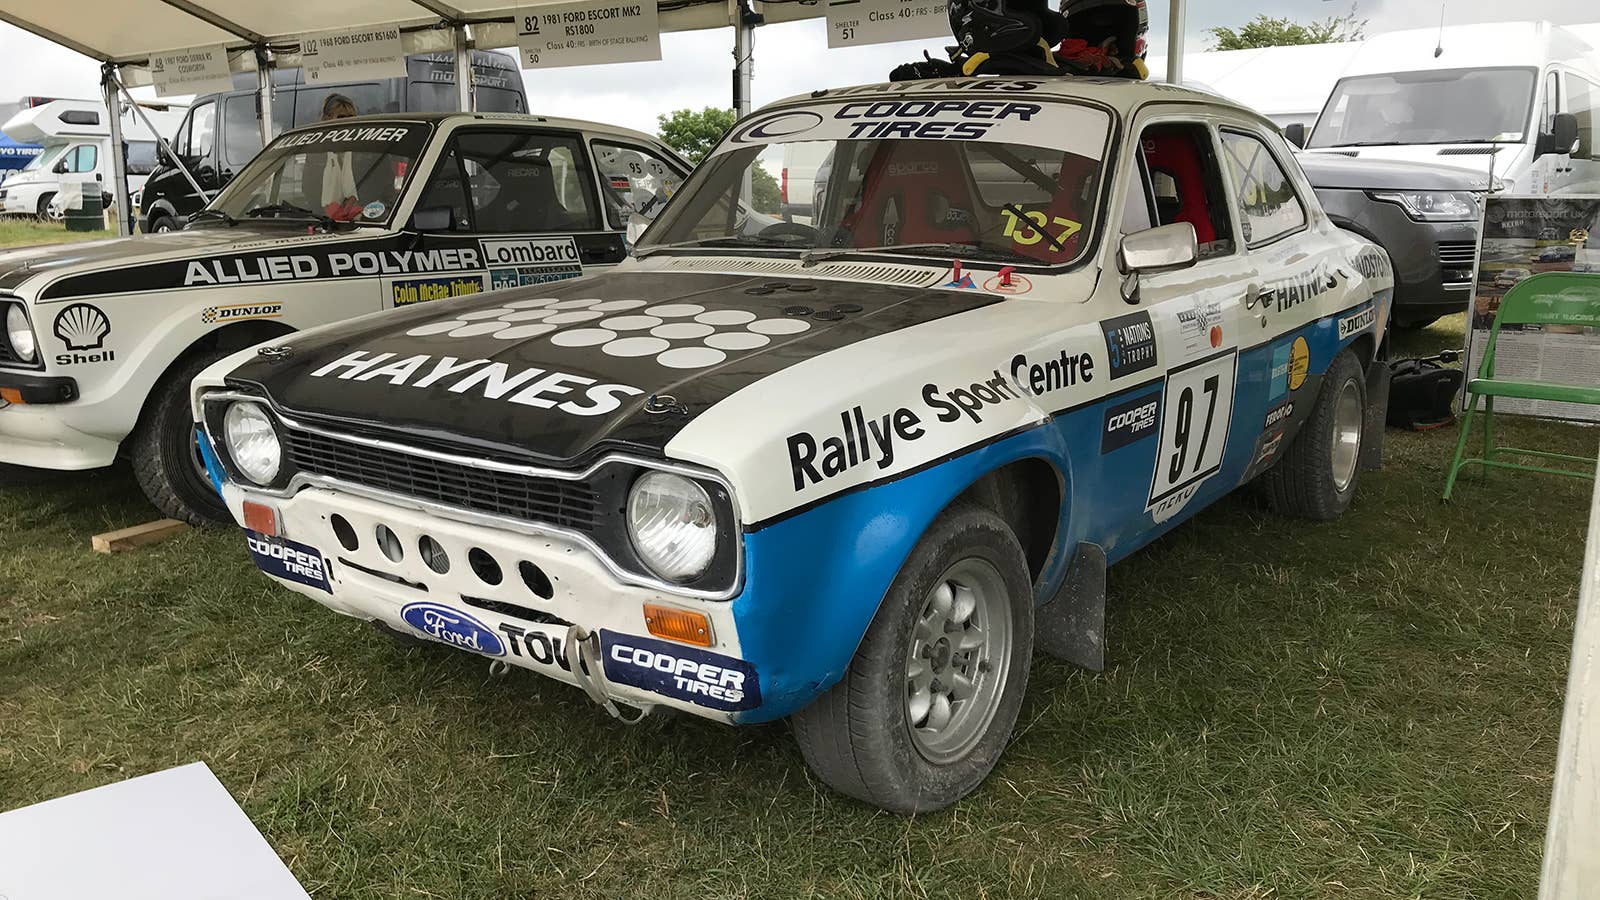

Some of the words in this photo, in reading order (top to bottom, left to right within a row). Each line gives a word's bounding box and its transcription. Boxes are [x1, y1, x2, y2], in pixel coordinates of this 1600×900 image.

[525, 16, 540, 32] 82
[543, 14, 561, 25] 1981
[563, 12, 586, 23] FORD
[588, 7, 620, 21] ESCORT
[622, 5, 641, 17] MK2
[835, 20, 860, 29] SHELTER
[869, 11, 894, 22] Class
[898, 8, 914, 18] 40:
[916, 7, 927, 16] FRS
[303, 39, 318, 53] 102
[320, 37, 334, 47] 1968
[334, 36, 351, 45] FORD
[351, 33, 374, 44] ESCORT
[375, 30, 398, 41] RS1600
[565, 24, 595, 36] RS1800
[842, 28, 854, 40] 51
[547, 41, 564, 50] Class
[566, 40, 577, 49] 40:
[530, 54, 540, 64] 50
[833, 101, 1042, 122] COOPER
[270, 132, 323, 150] ALLIED
[320, 127, 409, 143] POLYMER
[848, 121, 995, 139] TIRES
[629, 162, 642, 174] 95
[1000, 204, 1083, 252] 137
[481, 240, 579, 263] Lombard
[184, 254, 319, 286] ALLIED
[330, 248, 481, 278] POLYMER
[394, 283, 418, 303] Colin
[420, 283, 449, 300] McRae
[451, 279, 483, 297] Tribute
[219, 305, 282, 318] DUNLOP
[1122, 322, 1152, 346] NATIONS
[55, 350, 115, 365] Shell
[1108, 330, 1121, 368] 5
[1127, 345, 1154, 364] TROPHY
[310, 350, 645, 417] HAYNES
[786, 405, 926, 492] Rallye
[921, 368, 1020, 424] Sport
[1010, 350, 1094, 398] Centre
[1107, 401, 1158, 432] COOPER
[1130, 416, 1156, 434] TIRES
[1168, 374, 1220, 485] 97
[247, 535, 323, 572] COOPER
[283, 559, 325, 582] TIRES
[423, 609, 484, 654] Ford
[610, 643, 746, 690] COOPER
[673, 673, 746, 702] TIRES
